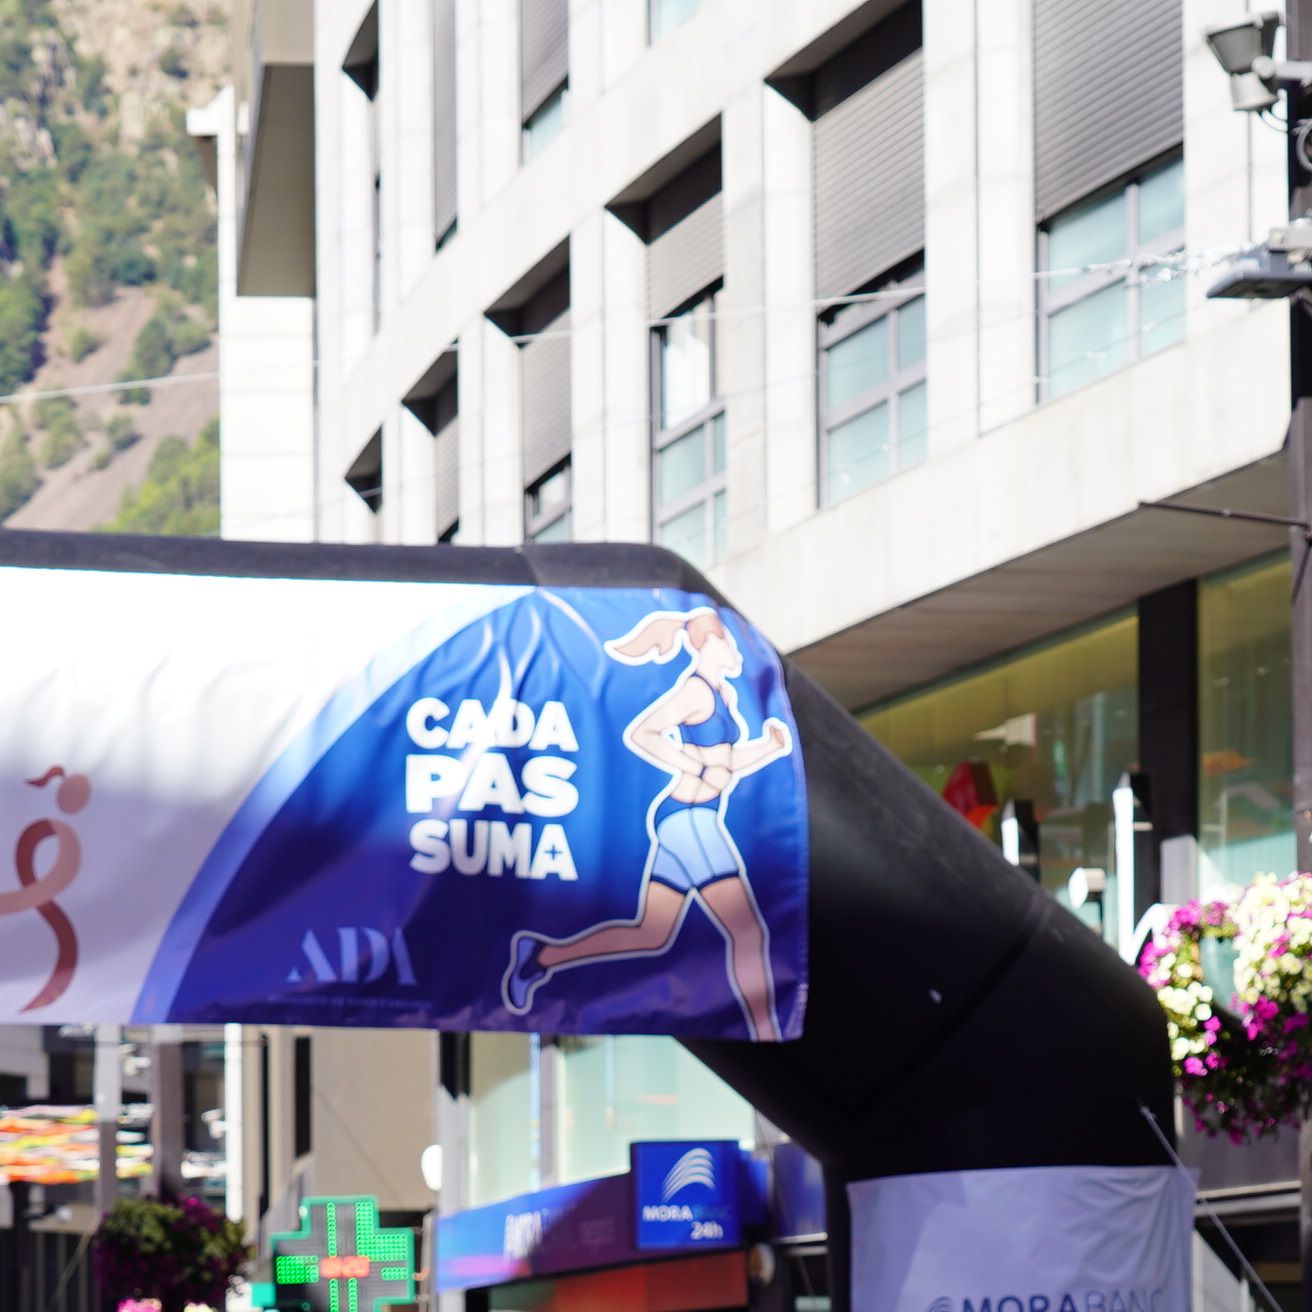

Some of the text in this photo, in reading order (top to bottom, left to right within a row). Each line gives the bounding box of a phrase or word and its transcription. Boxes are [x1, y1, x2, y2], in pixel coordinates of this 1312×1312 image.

[406, 697, 578, 753] CADA
[405, 753, 579, 815] PAS
[409, 820, 578, 881] SUMA
[690, 1221, 724, 1240] 24h
